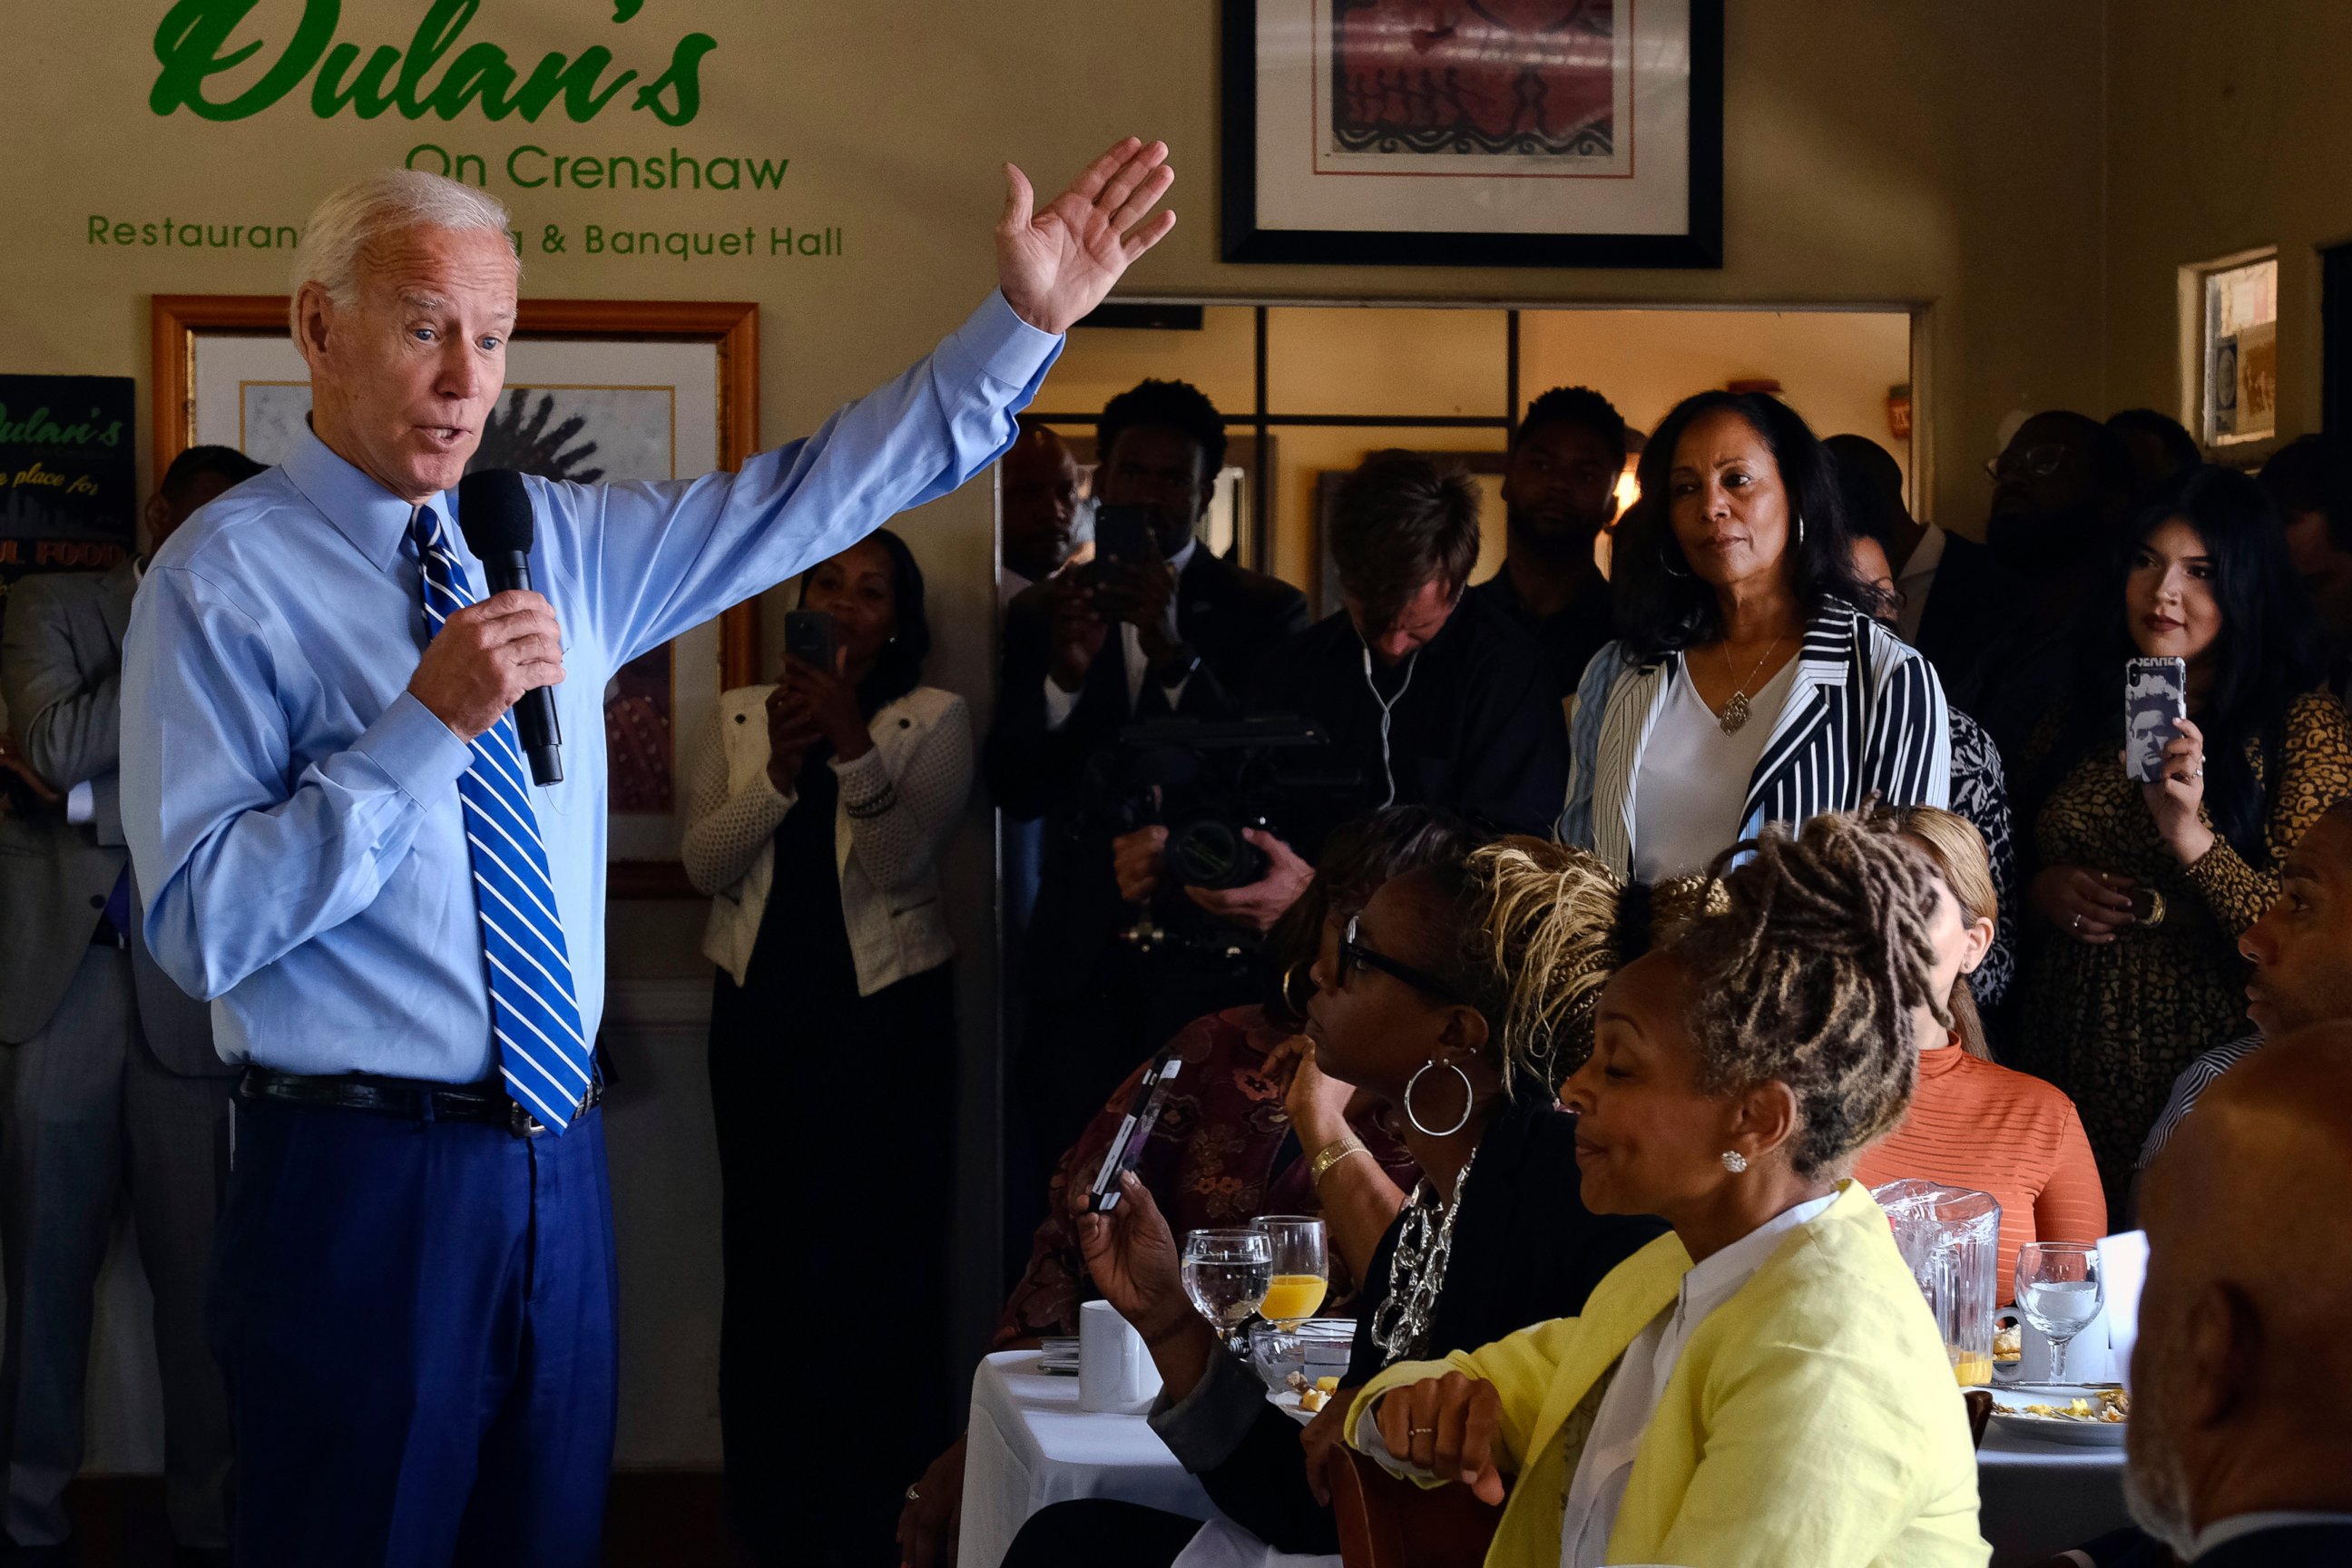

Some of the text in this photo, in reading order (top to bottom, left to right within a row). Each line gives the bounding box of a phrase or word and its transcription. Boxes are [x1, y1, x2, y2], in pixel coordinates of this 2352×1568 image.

[149, 0, 718, 126] Dulan's
[405, 143, 789, 191] On Crenshaw
[88, 215, 301, 249] Restauran
[542, 224, 567, 255] &
[585, 224, 756, 261] Banquet
[770, 227, 842, 257] Hall
[13, 462, 64, 487] place
[66, 475, 99, 495] for
[37, 540, 126, 567] FOOD
